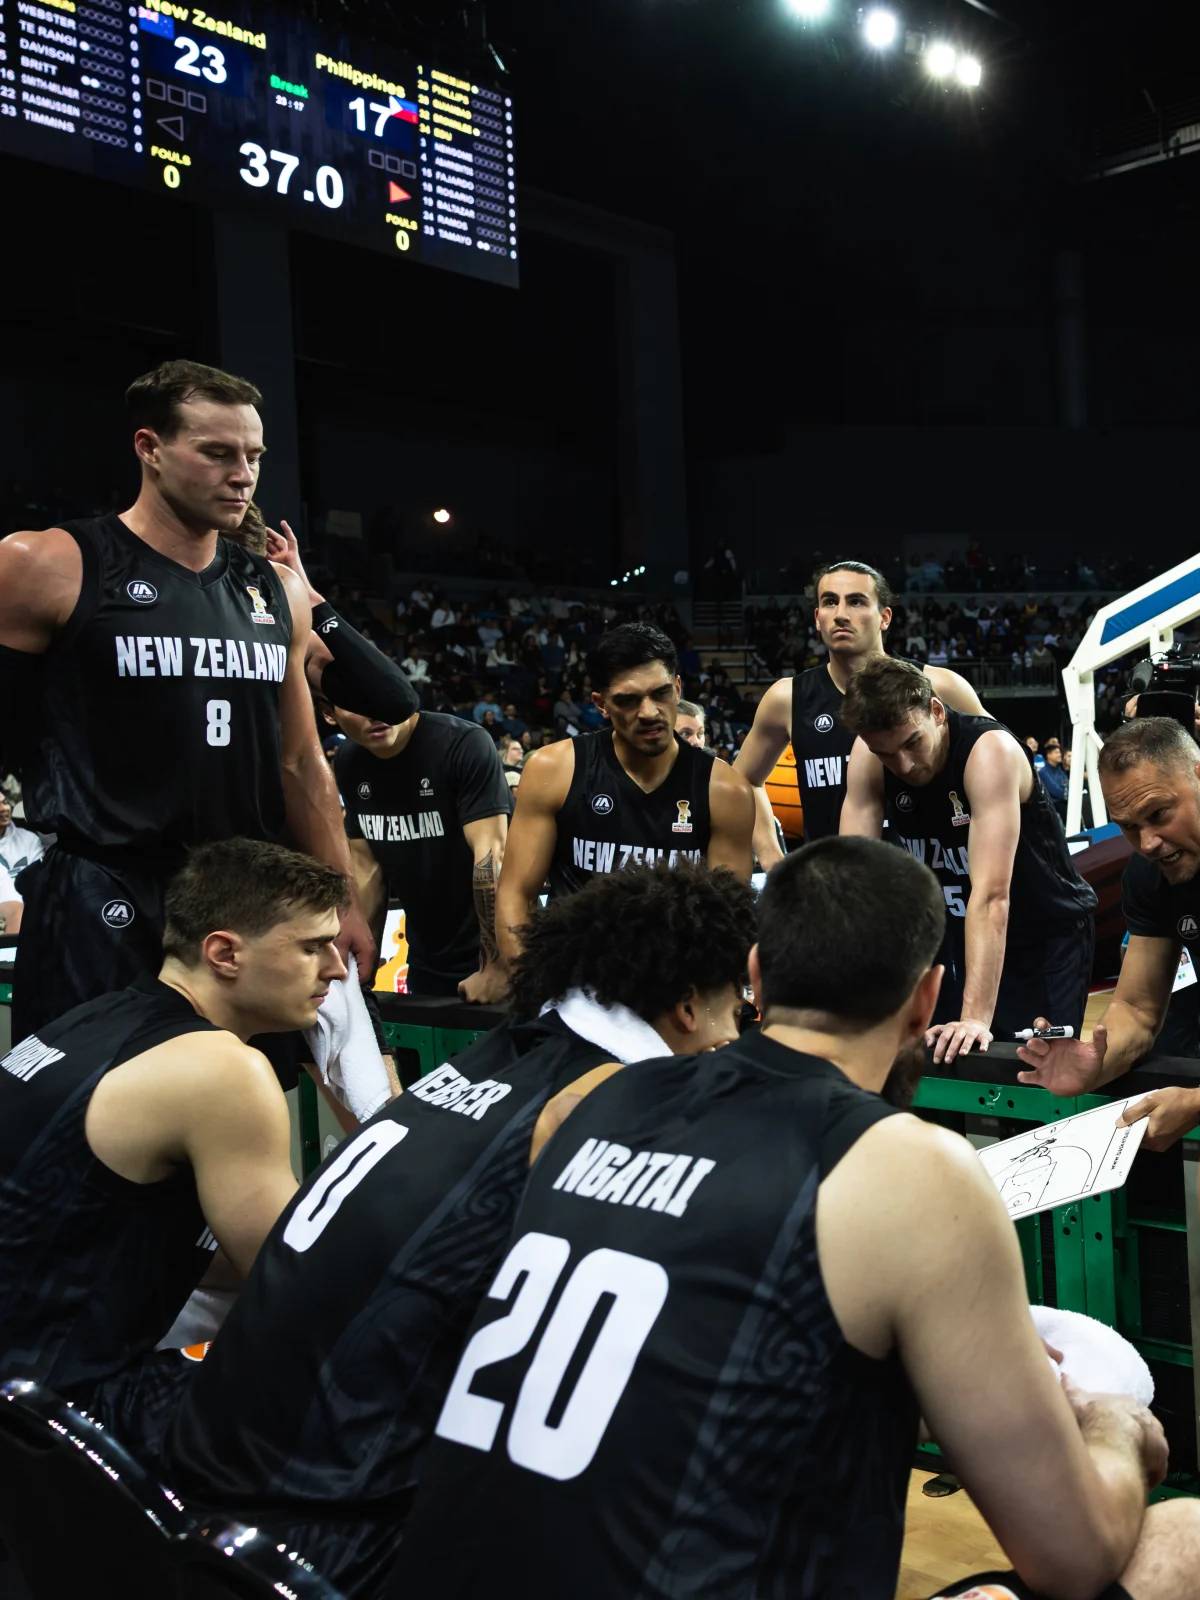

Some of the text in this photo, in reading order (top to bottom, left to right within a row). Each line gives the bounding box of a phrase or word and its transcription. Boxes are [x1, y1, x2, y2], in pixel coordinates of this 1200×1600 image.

[17, 1, 77, 31] WEBSTER
[145, 0, 267, 50] New Zealand
[18, 19, 36, 35] TE
[37, 25, 77, 48] RANGI
[19, 37, 76, 65] DAVISON
[20, 55, 58, 76] BRITT
[174, 36, 228, 84] 23
[270, 74, 309, 98] Break
[315, 53, 406, 99] Philippines
[22, 108, 76, 134] TIMMINS
[349, 97, 391, 137] 17
[151, 145, 192, 166] FOULS
[163, 164, 181, 189] 0
[239, 142, 344, 209] 37.0
[385, 213, 418, 231] FOULS
[396, 230, 410, 251] 0
[116, 636, 288, 683] NEW ZEALAND
[206, 700, 231, 747] 8
[804, 756, 842, 789] NEW
[358, 811, 445, 842] NEW ZEALAND
[573, 837, 616, 874] NEW
[283, 1119, 410, 1253] 0
[552, 1138, 717, 1218] NGATAI
[435, 1231, 669, 1481] 20
